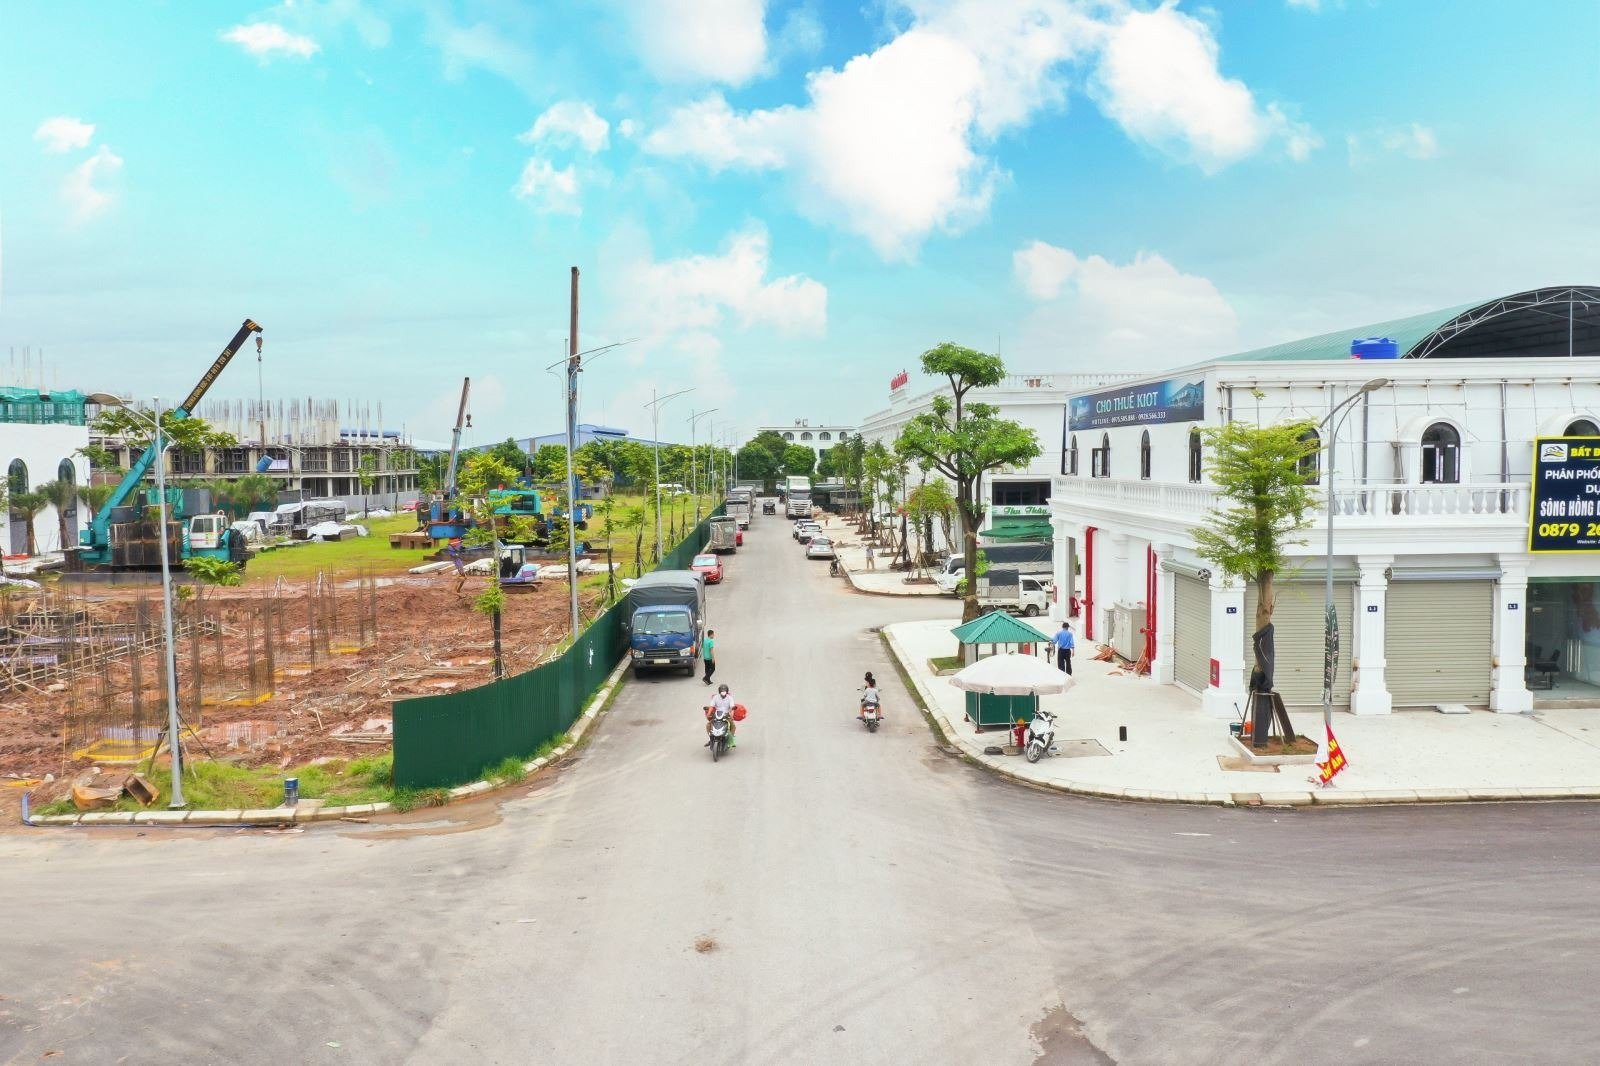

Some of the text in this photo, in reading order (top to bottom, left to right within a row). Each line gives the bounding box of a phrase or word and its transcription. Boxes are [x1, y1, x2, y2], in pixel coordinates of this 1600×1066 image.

[1096, 391, 1159, 414] CHO THUÊ KIOT
[1570, 445, 1591, 457] BẤT
[1545, 467, 1574, 480] PHÂN
[1540, 497, 1566, 517] SÔNG
[1568, 494, 1594, 516] HỒNG
[1539, 523, 1580, 537] 0879
